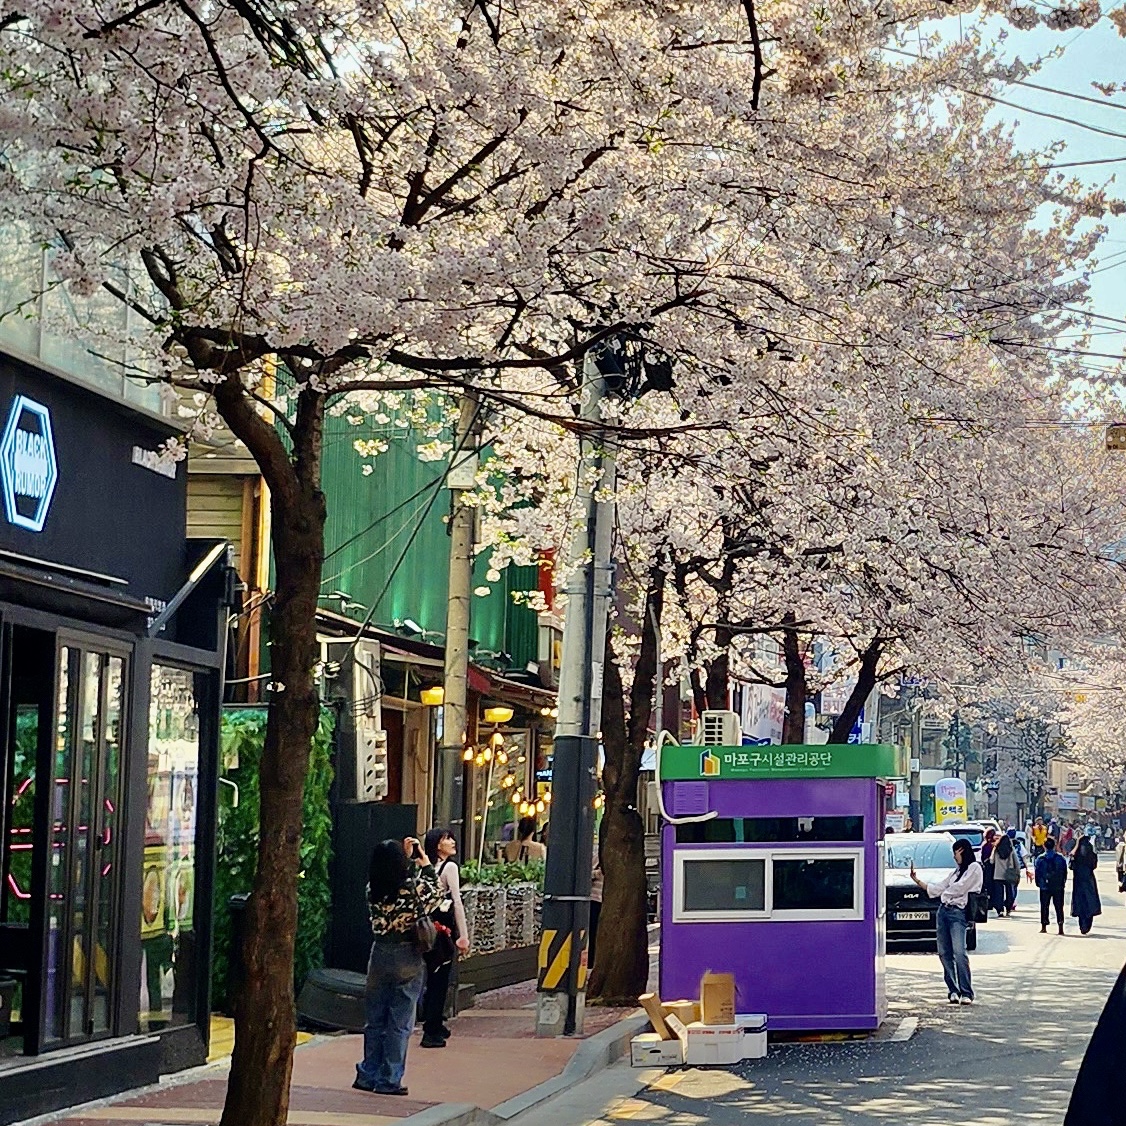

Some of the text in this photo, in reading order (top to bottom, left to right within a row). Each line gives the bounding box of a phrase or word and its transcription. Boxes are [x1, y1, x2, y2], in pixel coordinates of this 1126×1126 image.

[16, 428, 47, 461] BLACK
[15, 468, 47, 498] RUMOR
[723, 752, 832, 767] 마포구시설관리공단
